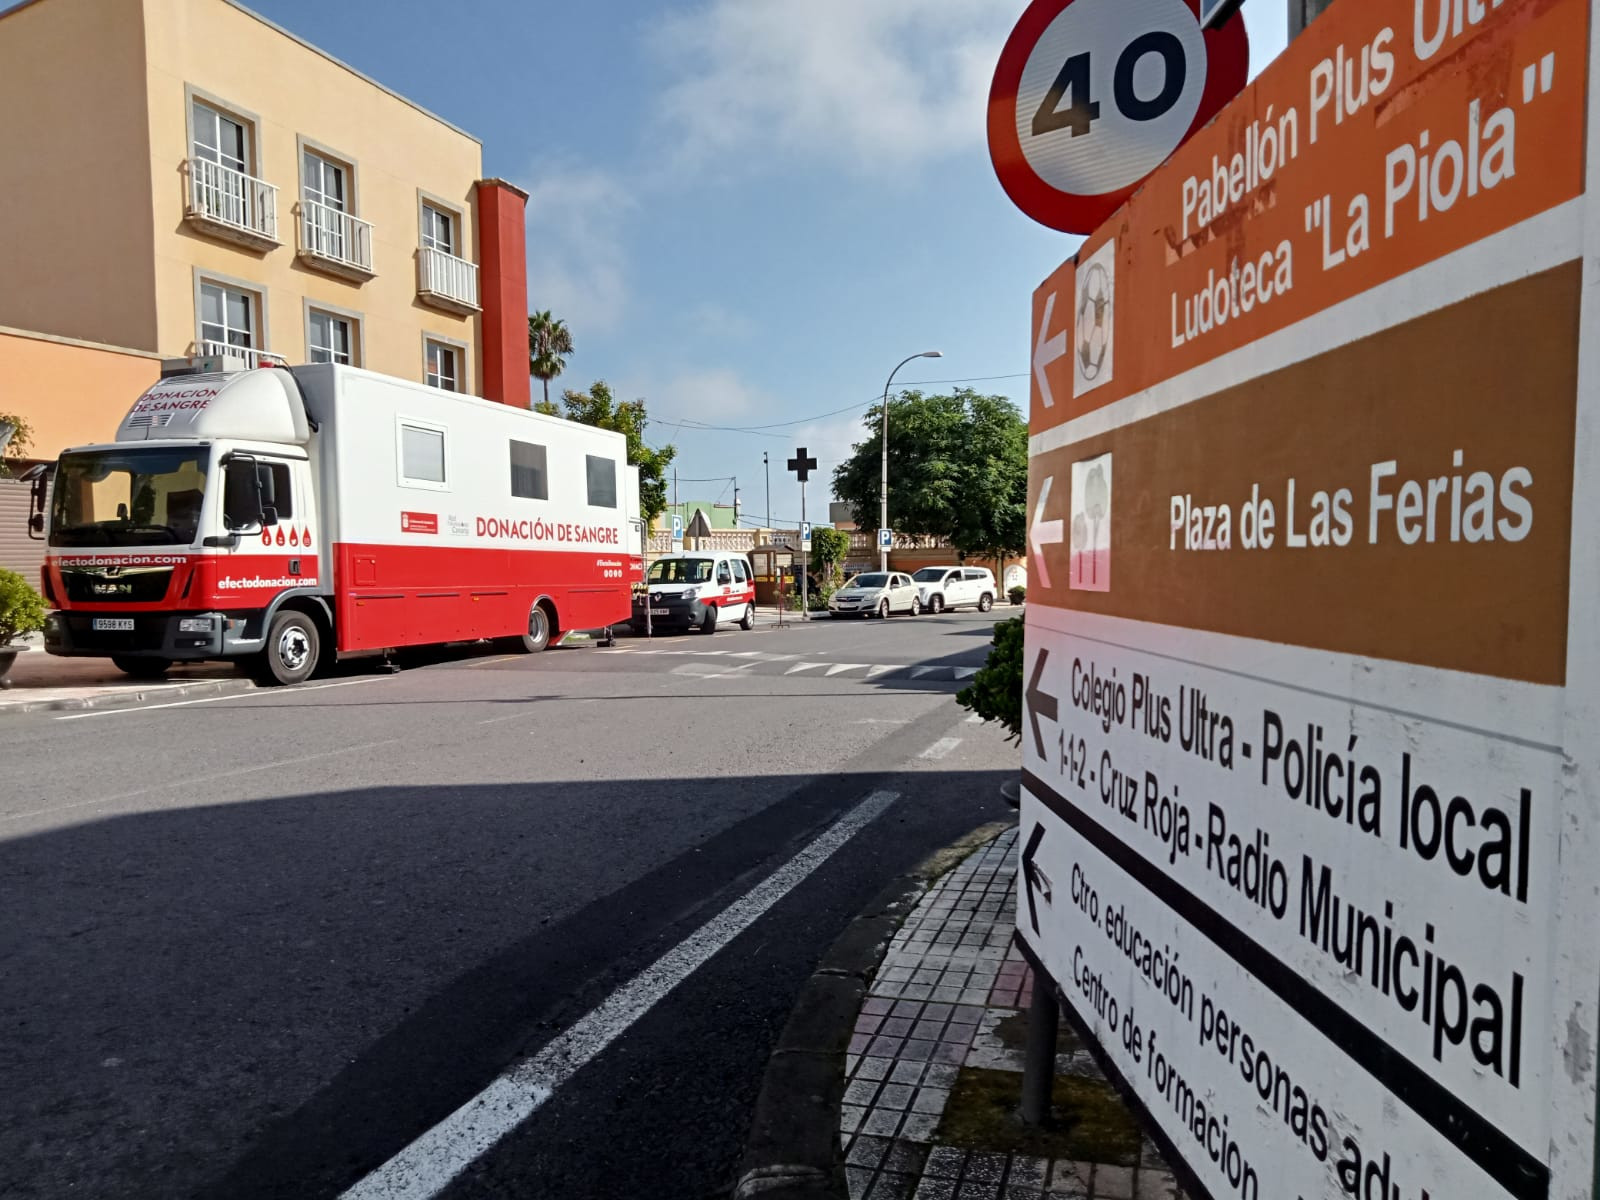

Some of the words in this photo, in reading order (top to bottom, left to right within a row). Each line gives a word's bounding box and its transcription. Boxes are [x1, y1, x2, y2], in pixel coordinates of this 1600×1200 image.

[1031, 30, 1187, 138] 40
[1181, 103, 1298, 240] Pabellón
[1309, 26, 1395, 145] Plus
[1171, 239, 1293, 349] Ludoteca
[142, 387, 220, 402] DONACIÓN
[150, 399, 211, 412] SANGRE
[476, 516, 554, 541] DONACIÓN
[557, 526, 573, 542] DE
[574, 525, 619, 545] SANGRE
[1169, 494, 1232, 551] Plaza
[1239, 483, 1275, 550] de
[1286, 478, 1354, 549] Las
[1368, 449, 1534, 546] Ferias
[51, 555, 187, 567] efectodonacion.com
[217, 575, 317, 589] efectodonacion.com
[1071, 657, 1126, 735] Colegio
[1132, 672, 1172, 744] Plus
[1179, 684, 1234, 771] Ultra
[1262, 708, 1382, 838] Policía
[1399, 752, 1533, 905] local
[1100, 749, 1138, 824] Cruz
[1144, 770, 1190, 866] Roja
[1206, 802, 1287, 920] Radio
[1300, 854, 1524, 1090] Municipal
[1071, 862, 1102, 929] Ctro.
[1105, 904, 1194, 1022] educación
[1200, 992, 1329, 1163] personas
[1073, 945, 1118, 1033] Centro
[1122, 1006, 1143, 1064] de
[1147, 1029, 1259, 1200] formacion
